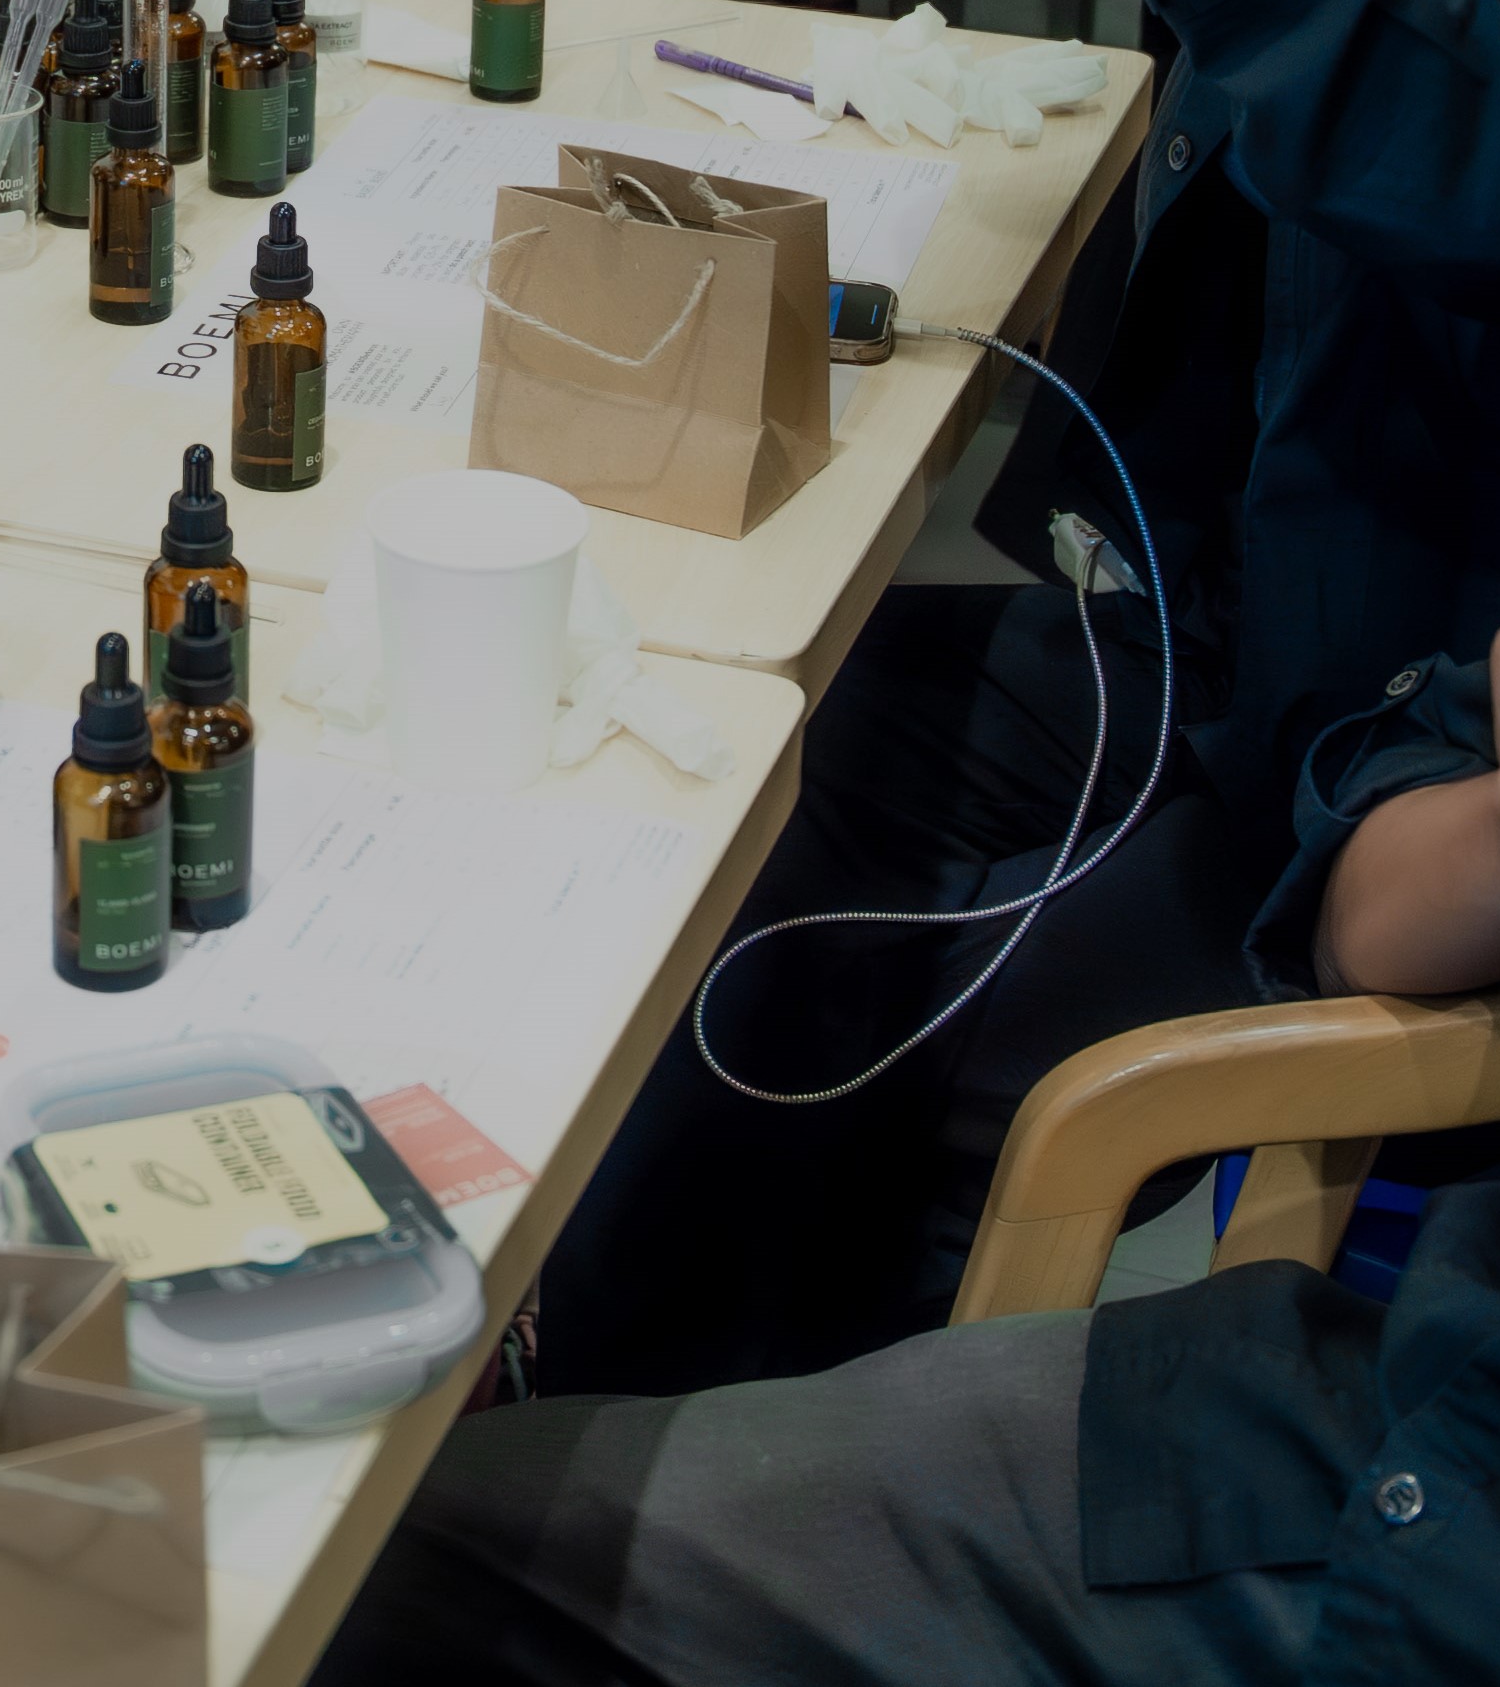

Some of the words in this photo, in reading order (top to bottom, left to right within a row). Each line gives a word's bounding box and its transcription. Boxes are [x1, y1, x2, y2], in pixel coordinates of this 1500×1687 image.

[321, 21, 353, 31] EXTRACT
[12, 176, 24, 188] ml
[157, 294, 257, 379] BOEMI
[439, 1167, 522, 1207] BOEM
